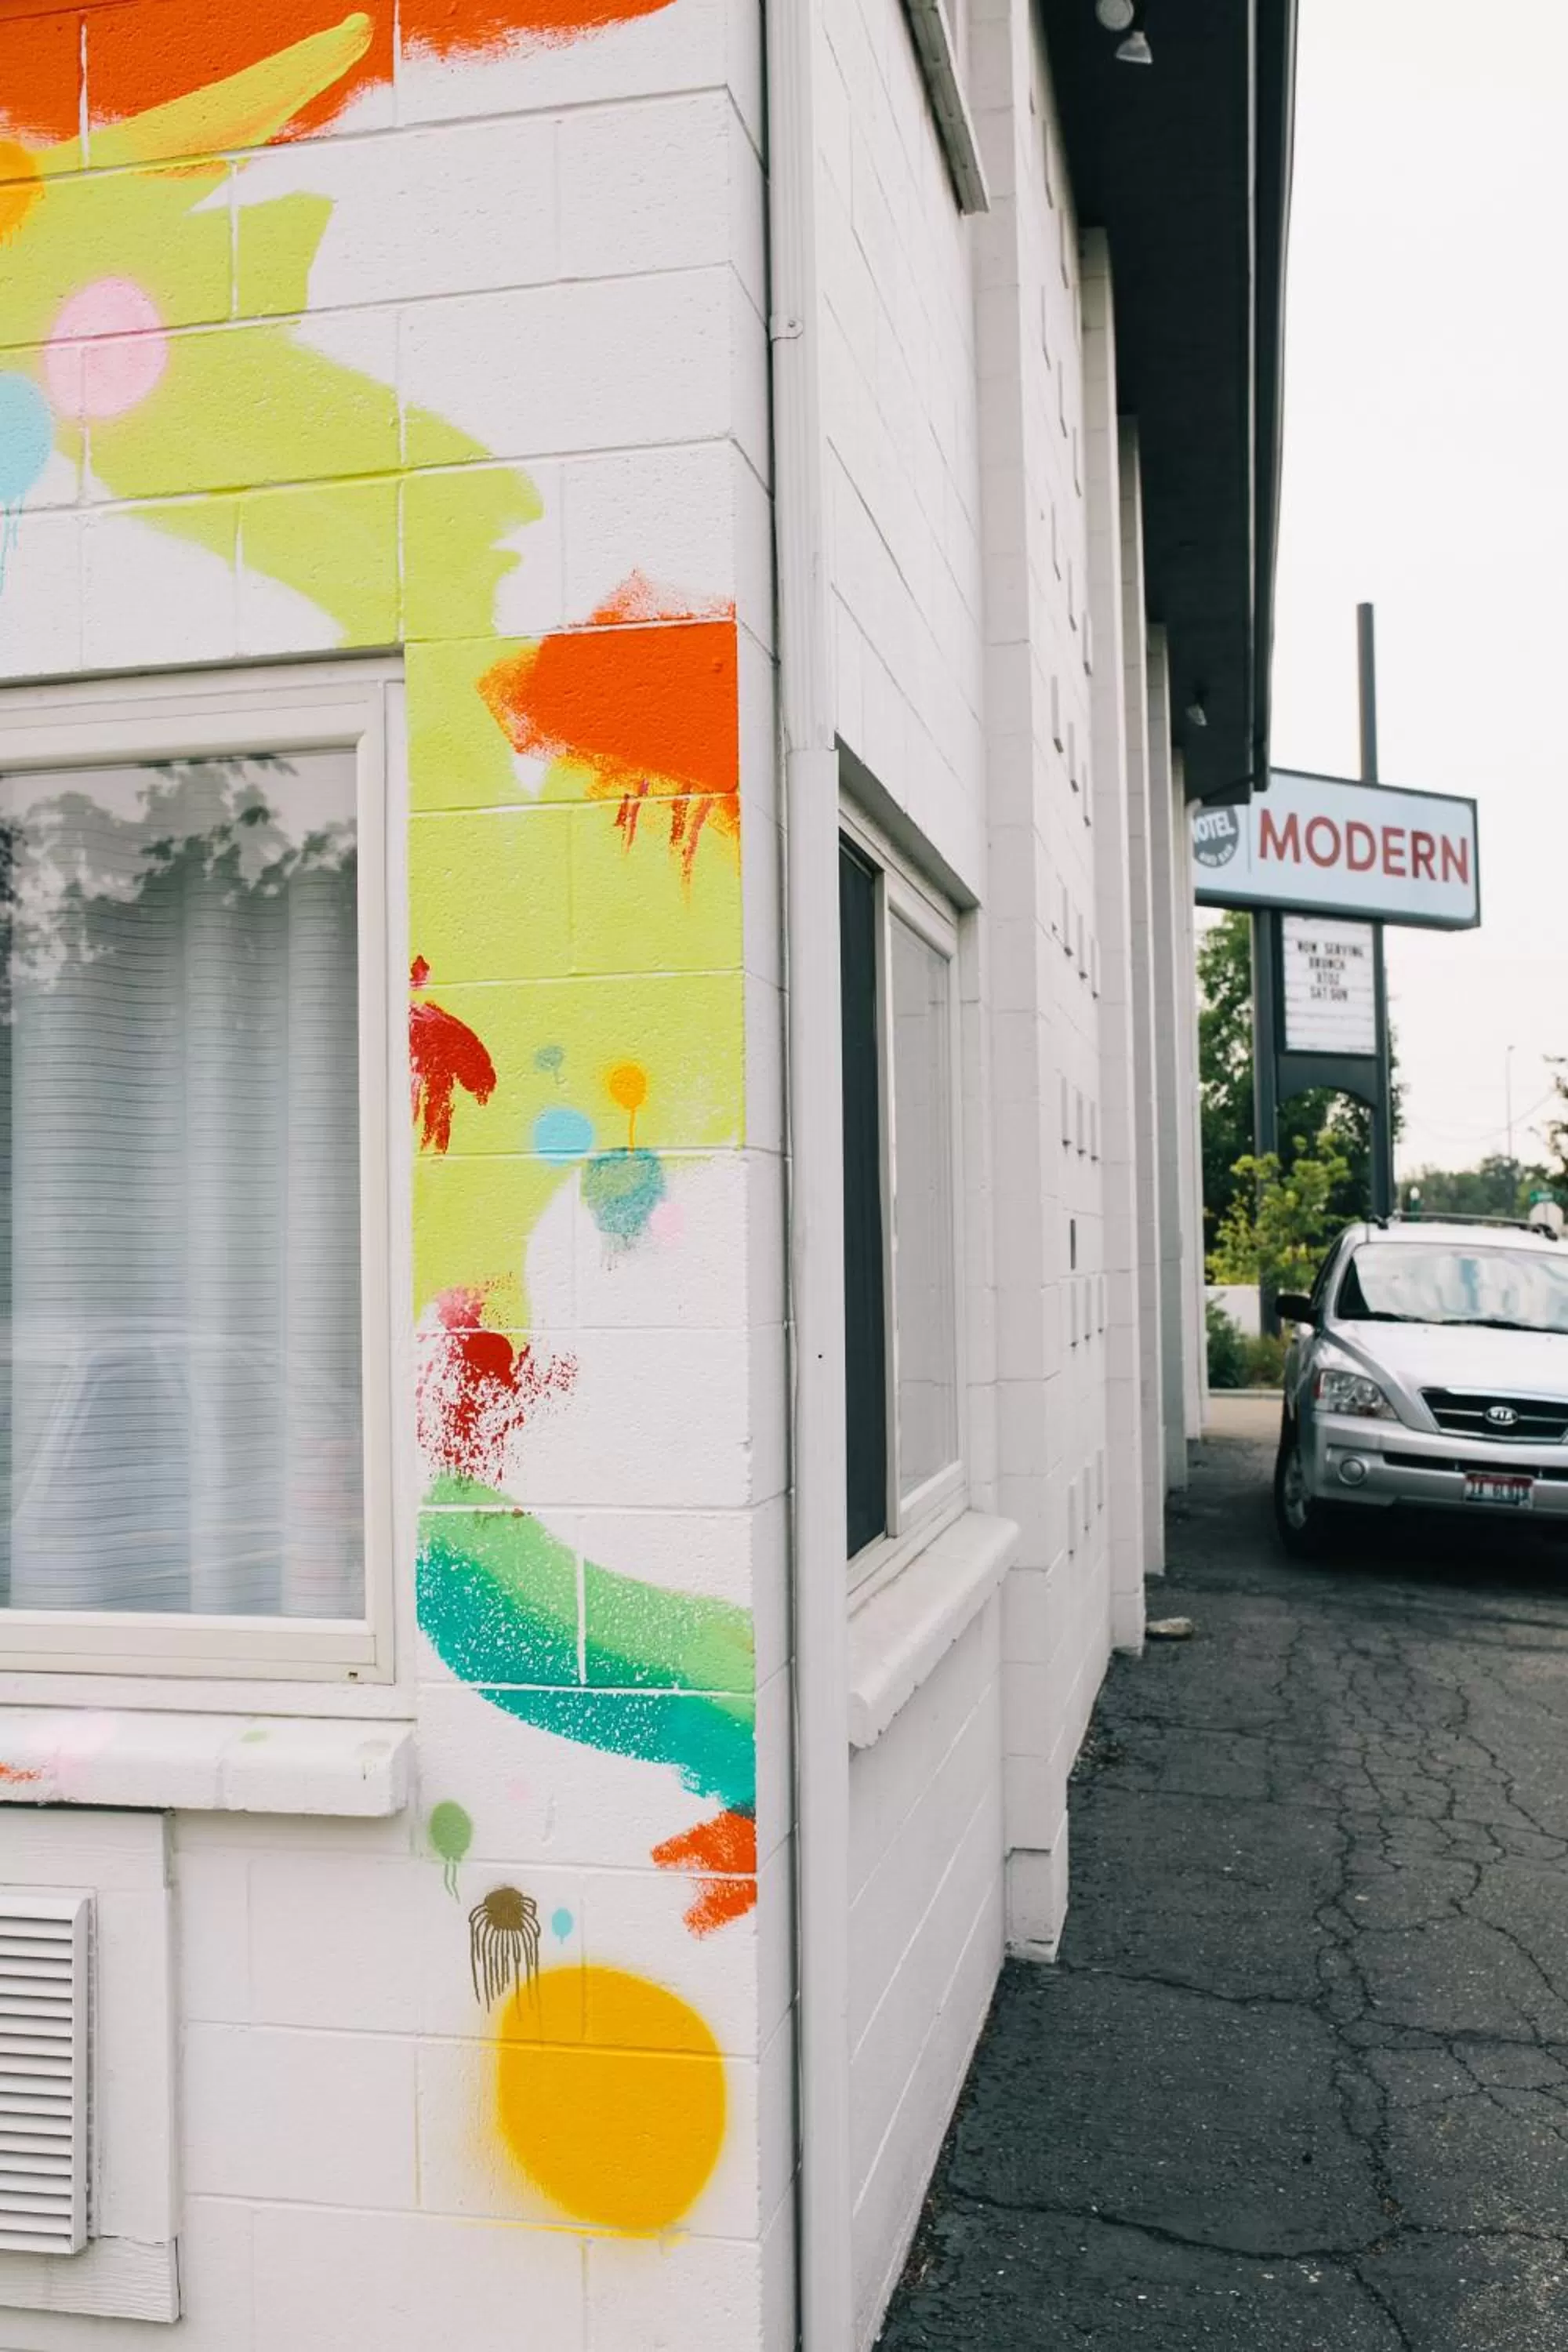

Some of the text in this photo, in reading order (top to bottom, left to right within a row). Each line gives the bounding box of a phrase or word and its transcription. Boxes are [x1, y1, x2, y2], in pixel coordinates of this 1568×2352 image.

[1259, 808, 1468, 885] MODERN
[1298, 941, 1363, 957] NOW SERVING
[1308, 956, 1345, 971] BRUNCH
